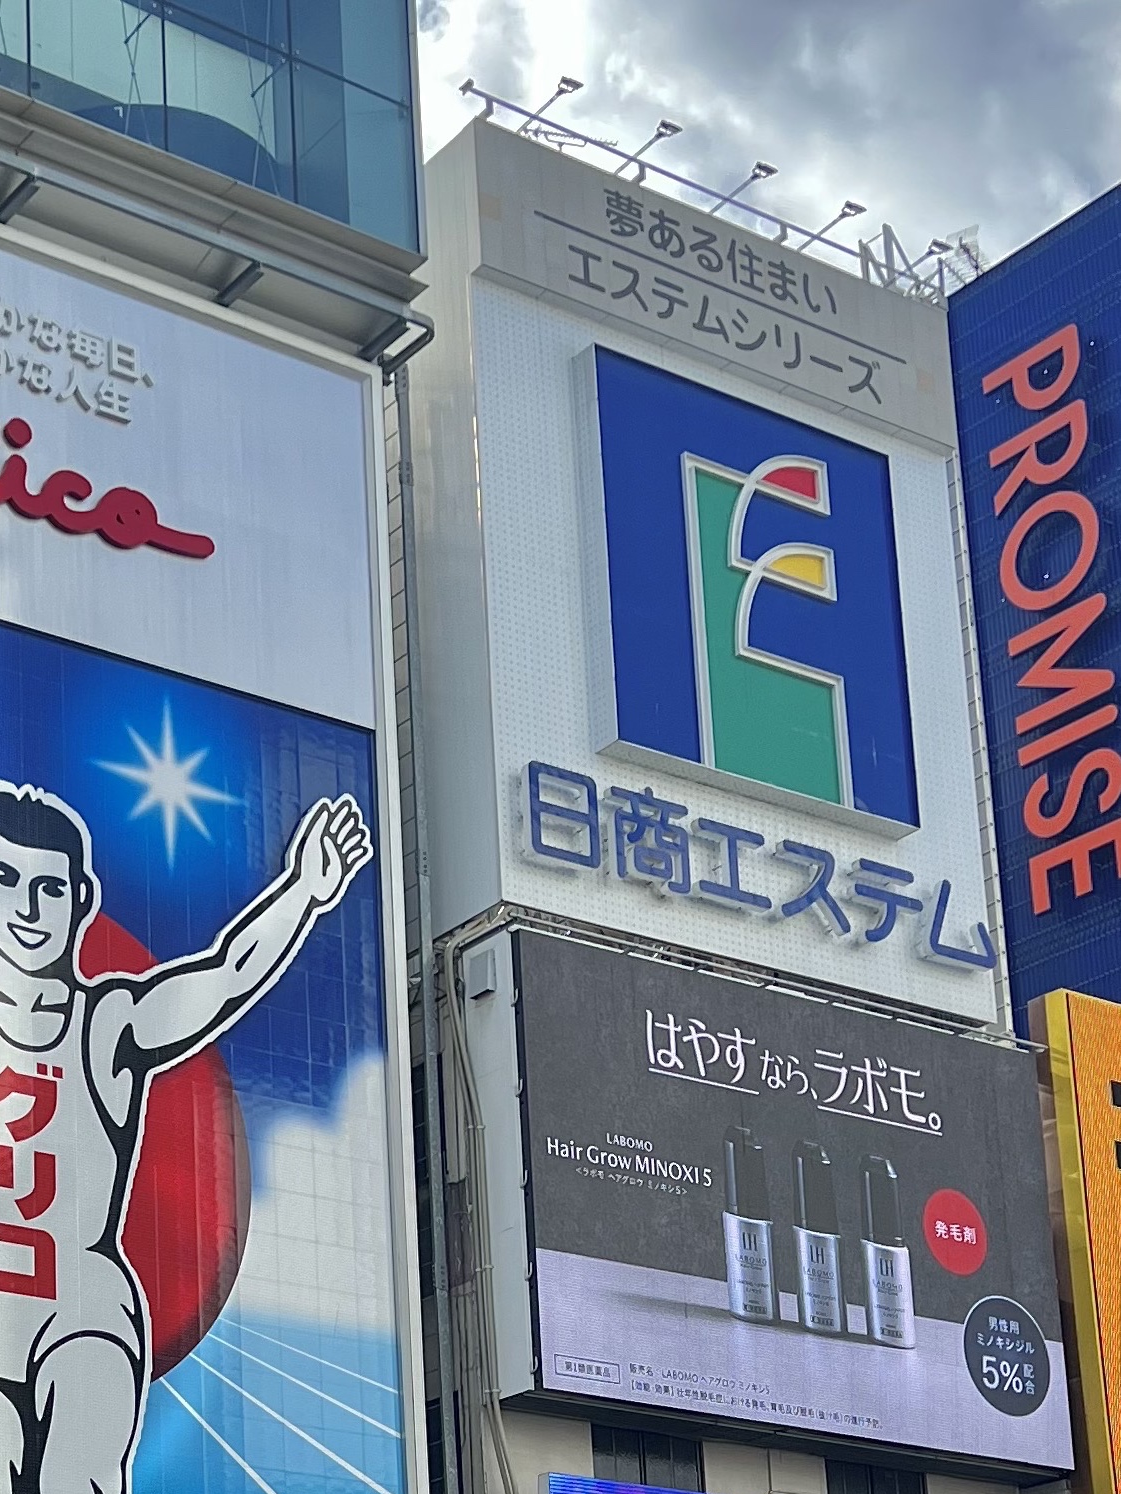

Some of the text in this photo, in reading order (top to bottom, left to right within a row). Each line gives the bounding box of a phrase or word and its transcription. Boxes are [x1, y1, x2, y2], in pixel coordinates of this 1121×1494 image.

[603, 187, 839, 316] 夢ある住まい
[568, 244, 883, 405] エステムシリーズ
[982, 323, 1121, 915] PROMISE
[524, 760, 997, 971] 日商エステム
[546, 1137, 583, 1160] Hair
[587, 1145, 632, 1170] Grow
[606, 1132, 653, 1153] LABOMO
[935, 1220, 977, 1245] 発毛剤
[988, 1315, 1020, 1335] 男性用
[976, 1332, 1034, 1354] ミノキシジル
[981, 1355, 1023, 1393] 5%
